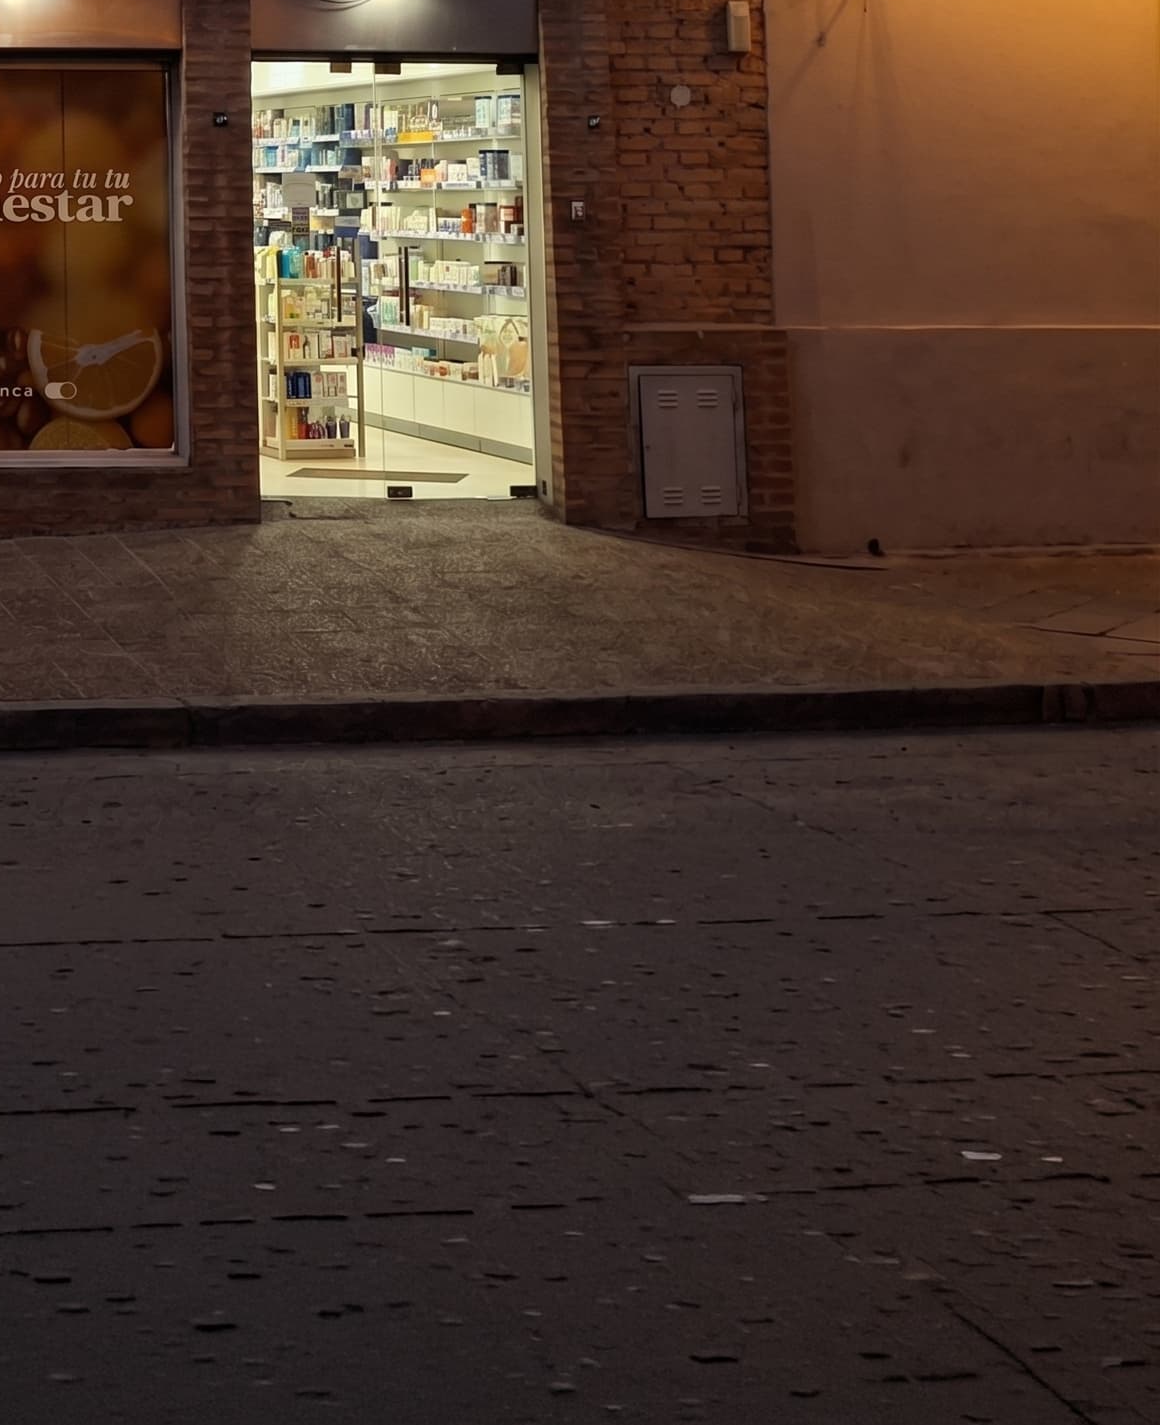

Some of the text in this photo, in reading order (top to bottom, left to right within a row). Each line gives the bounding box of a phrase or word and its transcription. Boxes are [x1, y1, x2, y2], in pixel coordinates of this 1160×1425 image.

[8, 169, 65, 194] para
[73, 169, 97, 189] tu
[105, 169, 131, 189] tu
